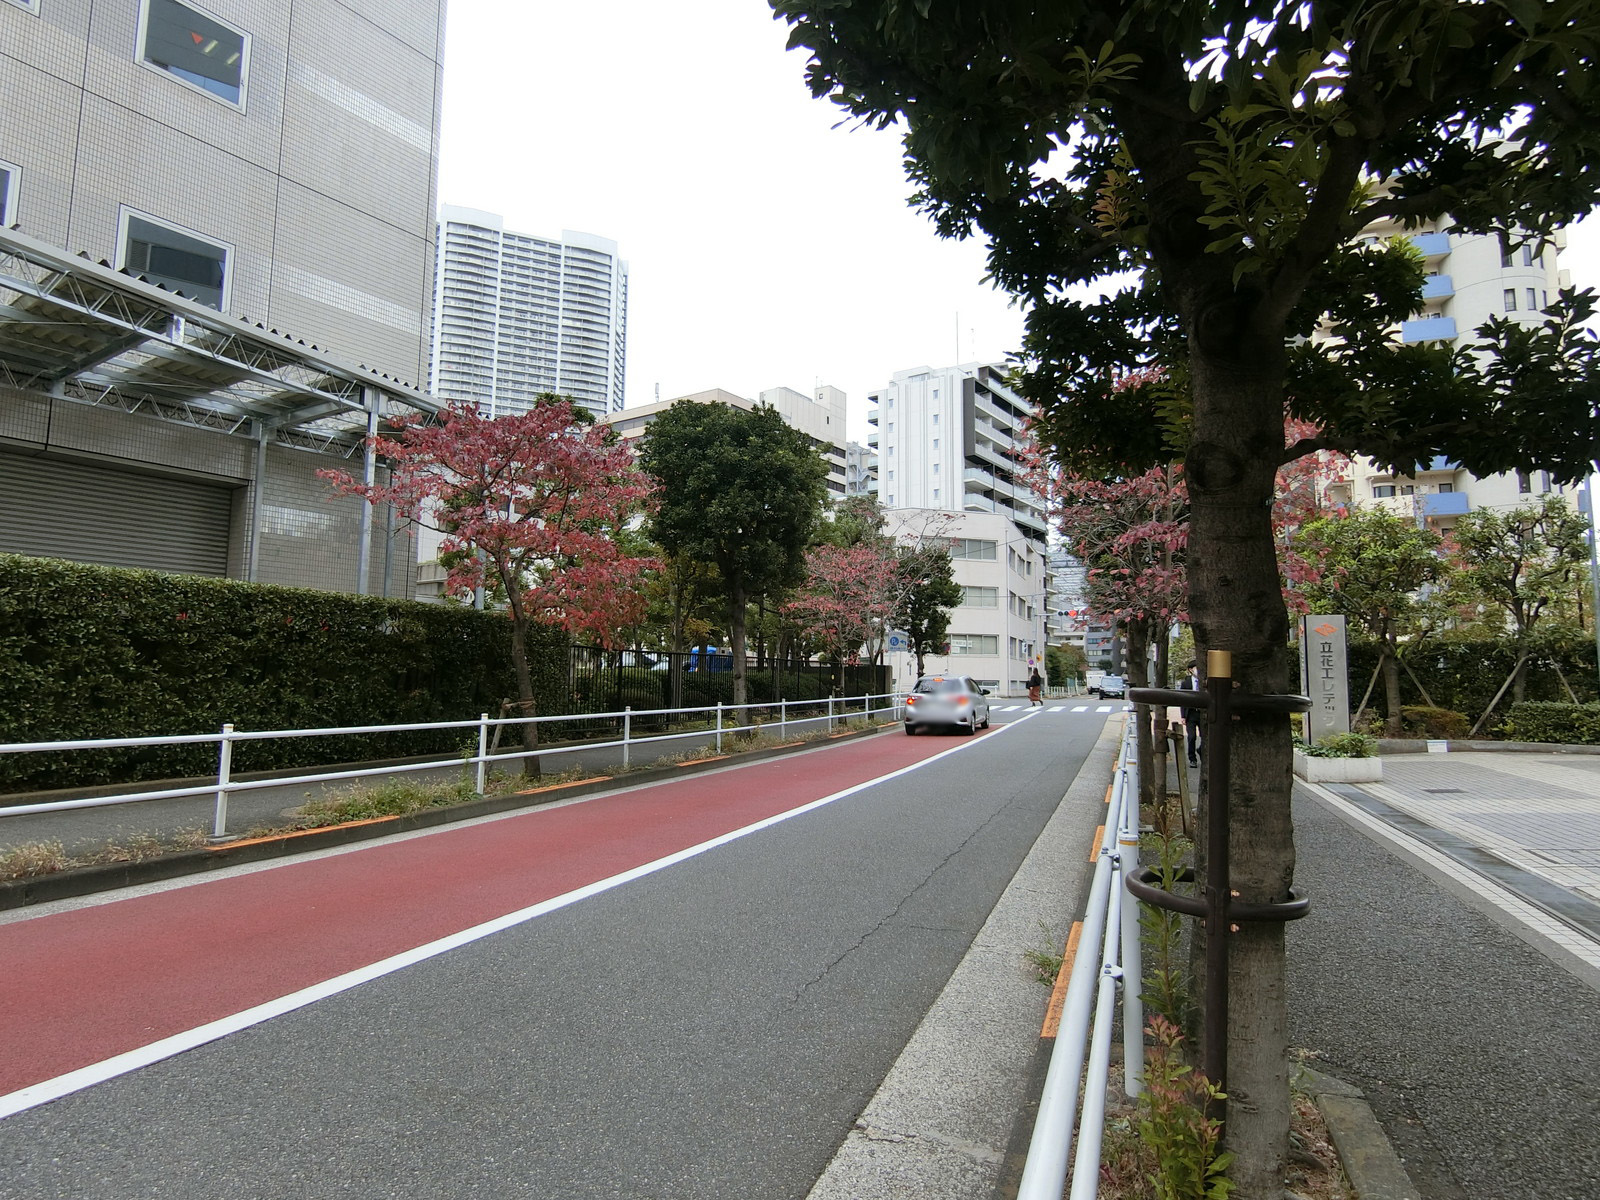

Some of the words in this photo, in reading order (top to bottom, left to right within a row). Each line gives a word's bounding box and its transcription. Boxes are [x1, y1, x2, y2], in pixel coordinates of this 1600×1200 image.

[1320, 641, 1336, 727] 立花エレテック
